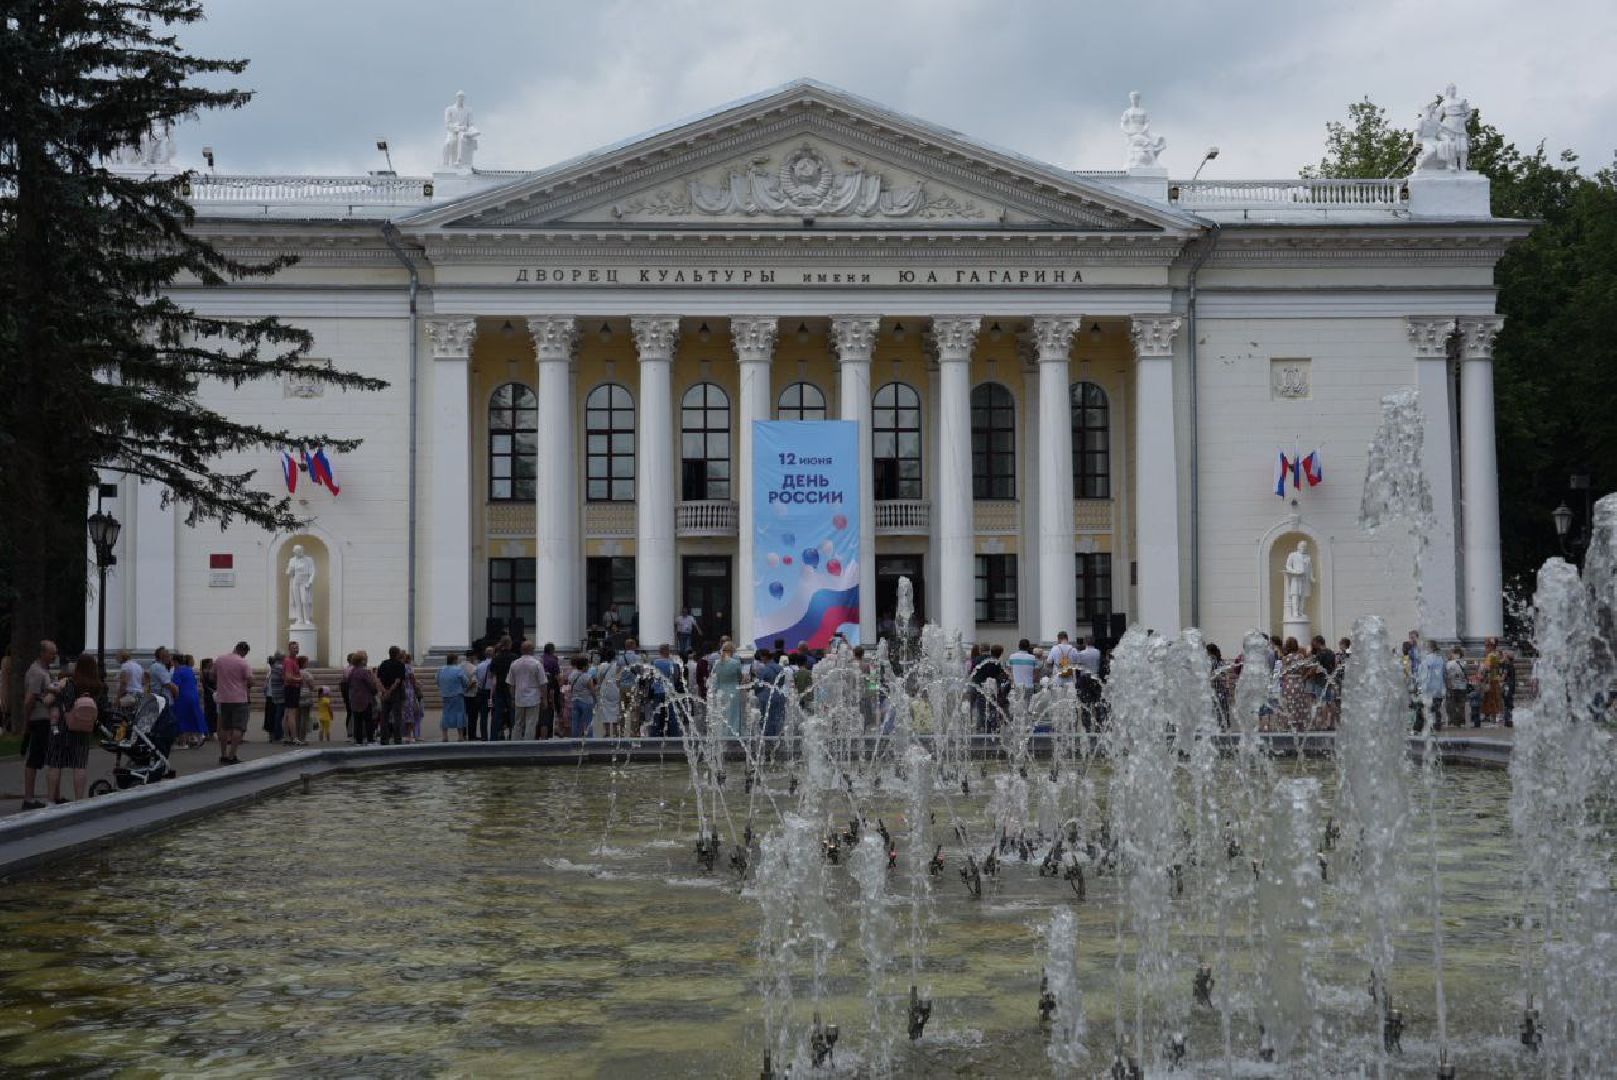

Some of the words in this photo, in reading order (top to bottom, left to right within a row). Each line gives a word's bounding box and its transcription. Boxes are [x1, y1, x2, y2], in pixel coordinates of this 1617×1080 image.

[516, 269, 618, 284] ДВОРЕЦ
[640, 270, 775, 283] КУЛЬТУРЫ
[956, 270, 1084, 283] ГАГАРИНА
[778, 452, 796, 465] 12
[782, 473, 829, 490] ДЕНЬ
[768, 490, 843, 505] РОССИИ
